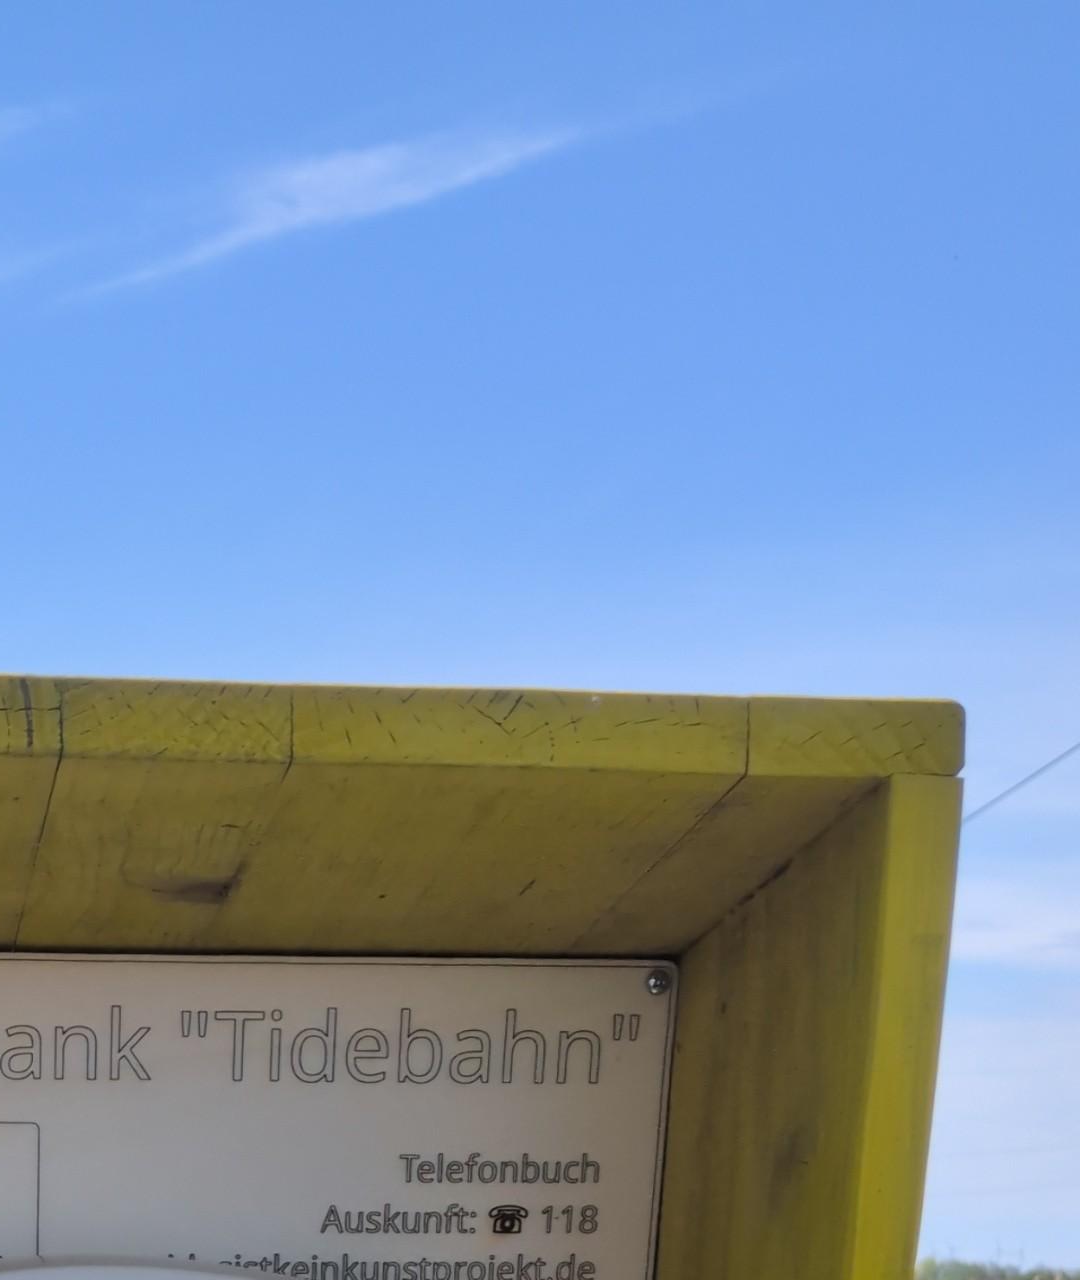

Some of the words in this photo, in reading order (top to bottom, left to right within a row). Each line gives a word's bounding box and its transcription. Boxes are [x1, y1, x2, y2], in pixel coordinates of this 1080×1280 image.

[181, 1007, 641, 1085] "Tidebahn"
[399, 1152, 601, 1184] Telefonbuch
[320, 1203, 478, 1235] Auskunft:
